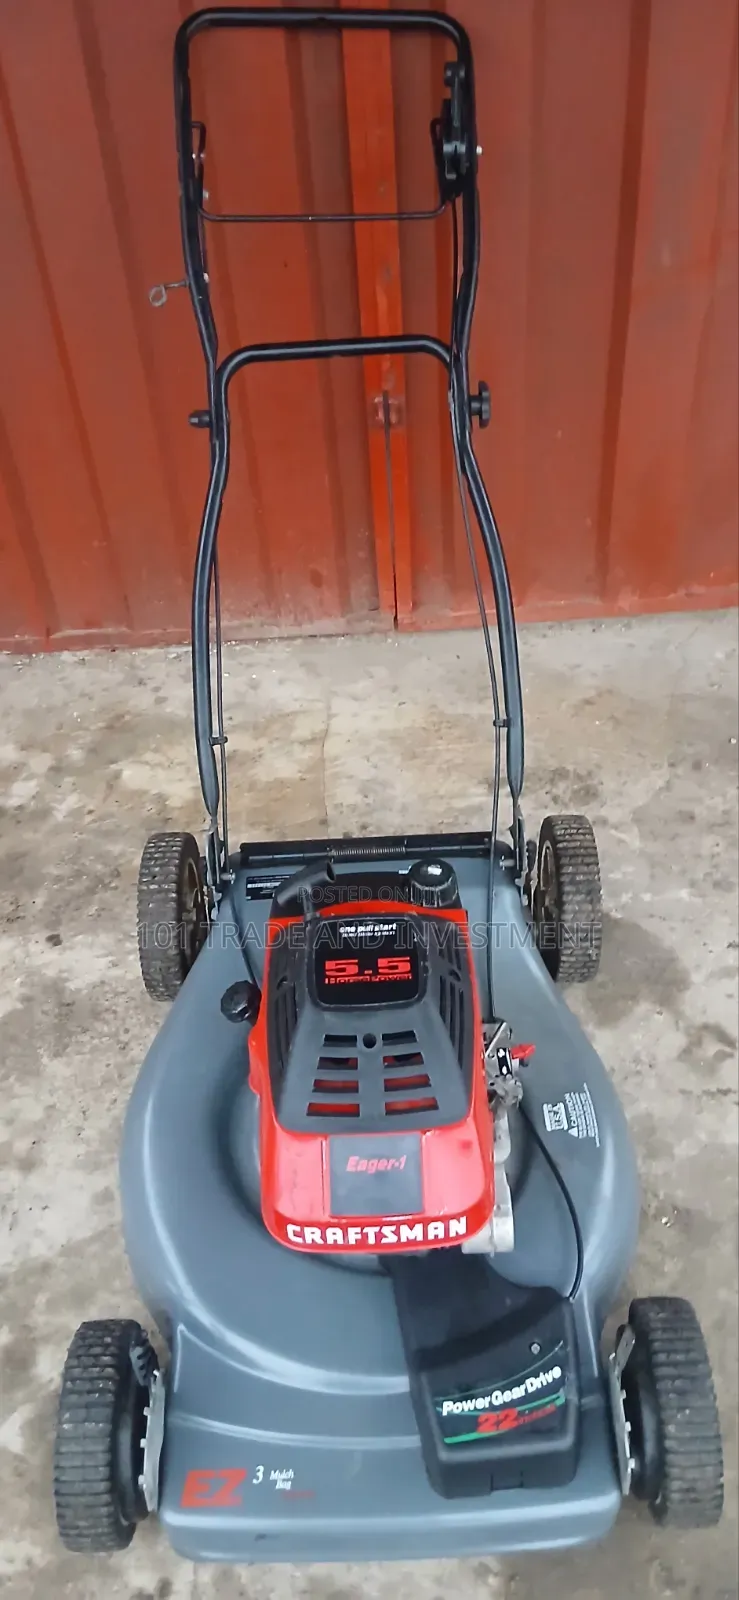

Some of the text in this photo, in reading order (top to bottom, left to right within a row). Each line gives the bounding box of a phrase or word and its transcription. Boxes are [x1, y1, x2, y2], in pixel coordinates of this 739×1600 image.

[357, 924, 373, 933] pull
[374, 922, 396, 931] start
[325, 956, 411, 976] 5.5
[346, 1155, 407, 1174] Eager-1
[286, 1216, 467, 1245] CRAFTSMAN
[476, 1407, 518, 1434] 22
[269, 1468, 295, 1481] Mulch
[180, 1465, 264, 1508] EZ 3
[275, 1479, 292, 1490] Bag
